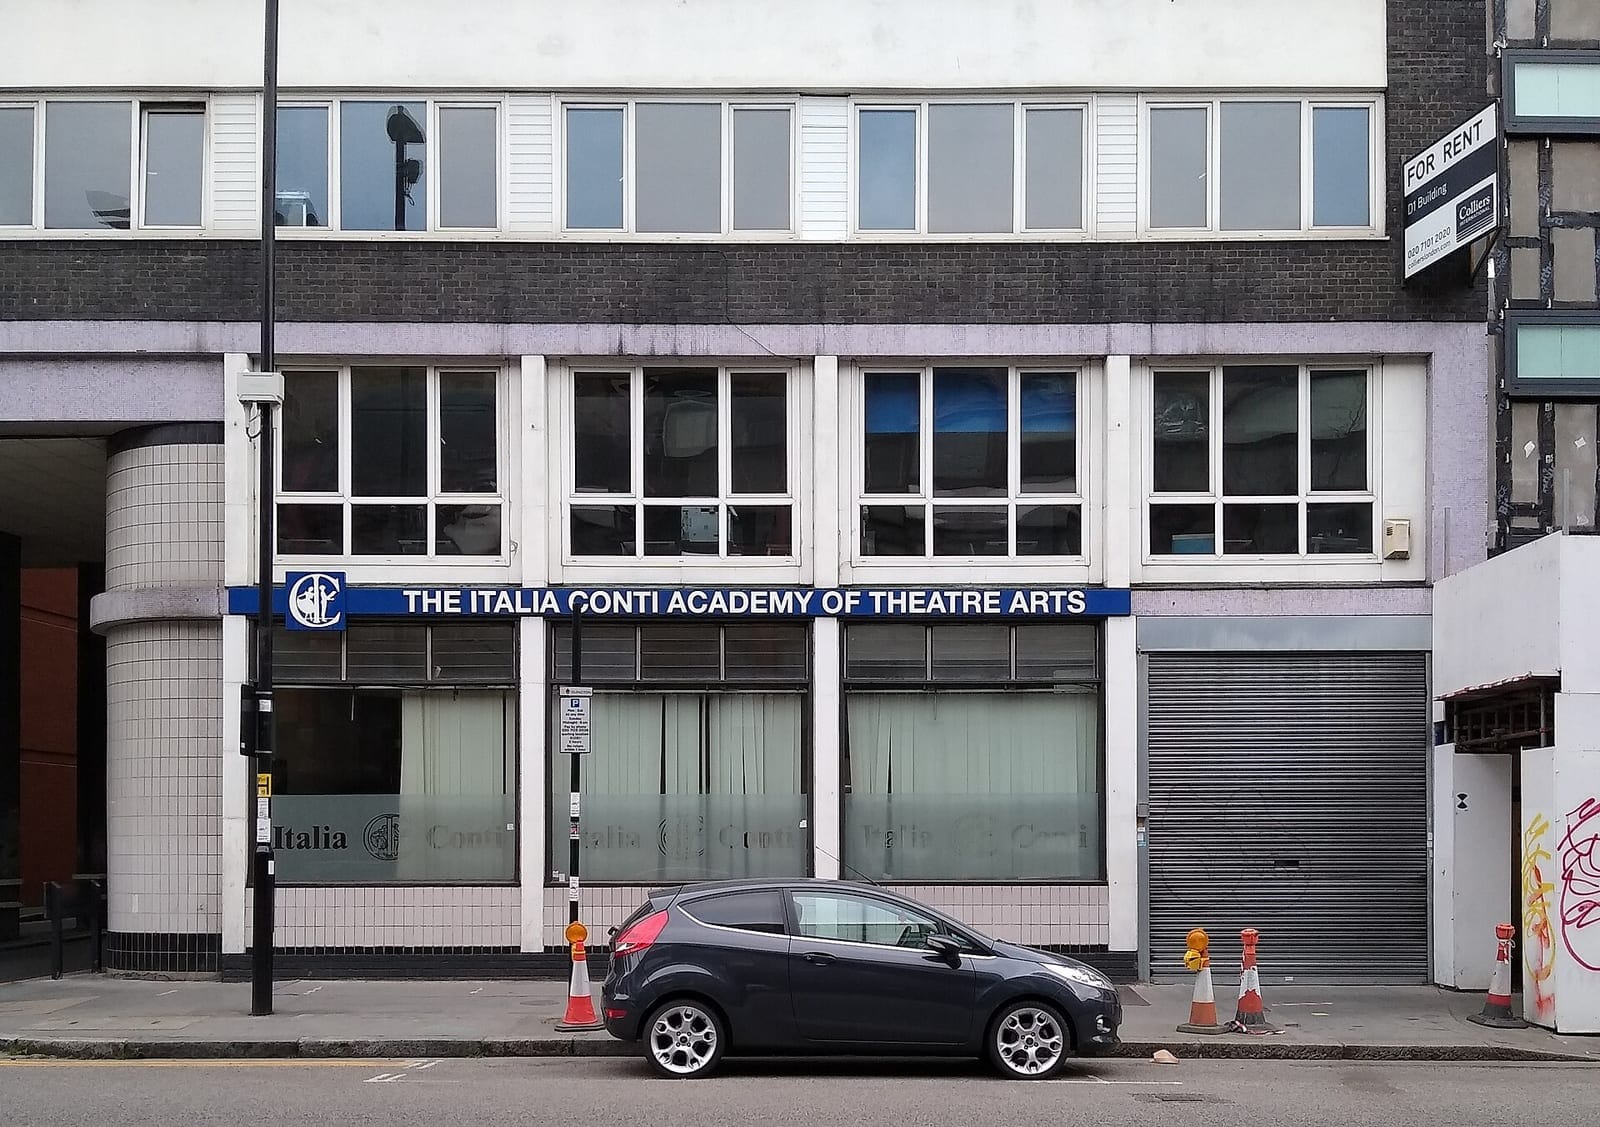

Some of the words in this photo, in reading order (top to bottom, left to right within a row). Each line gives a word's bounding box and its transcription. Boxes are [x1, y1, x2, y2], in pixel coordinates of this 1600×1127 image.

[1408, 153, 1435, 187] FOR
[1443, 119, 1483, 163] RENT
[1408, 200, 1416, 215] D1
[1417, 183, 1448, 208] Building
[1459, 196, 1491, 219] Colliers
[1407, 246, 1420, 258] 020
[1420, 236, 1434, 251] 7101
[1435, 226, 1451, 242] 2020
[403, 590, 461, 613] THE
[470, 590, 560, 613] ITALIA
[568, 590, 658, 614] CONTI
[666, 590, 812, 614] ACADEMY
[822, 590, 865, 614] OF
[869, 590, 1000, 614] THEATRE
[1008, 590, 1087, 614] ARTS
[273, 825, 348, 849] Italia
[582, 825, 641, 849] talia
